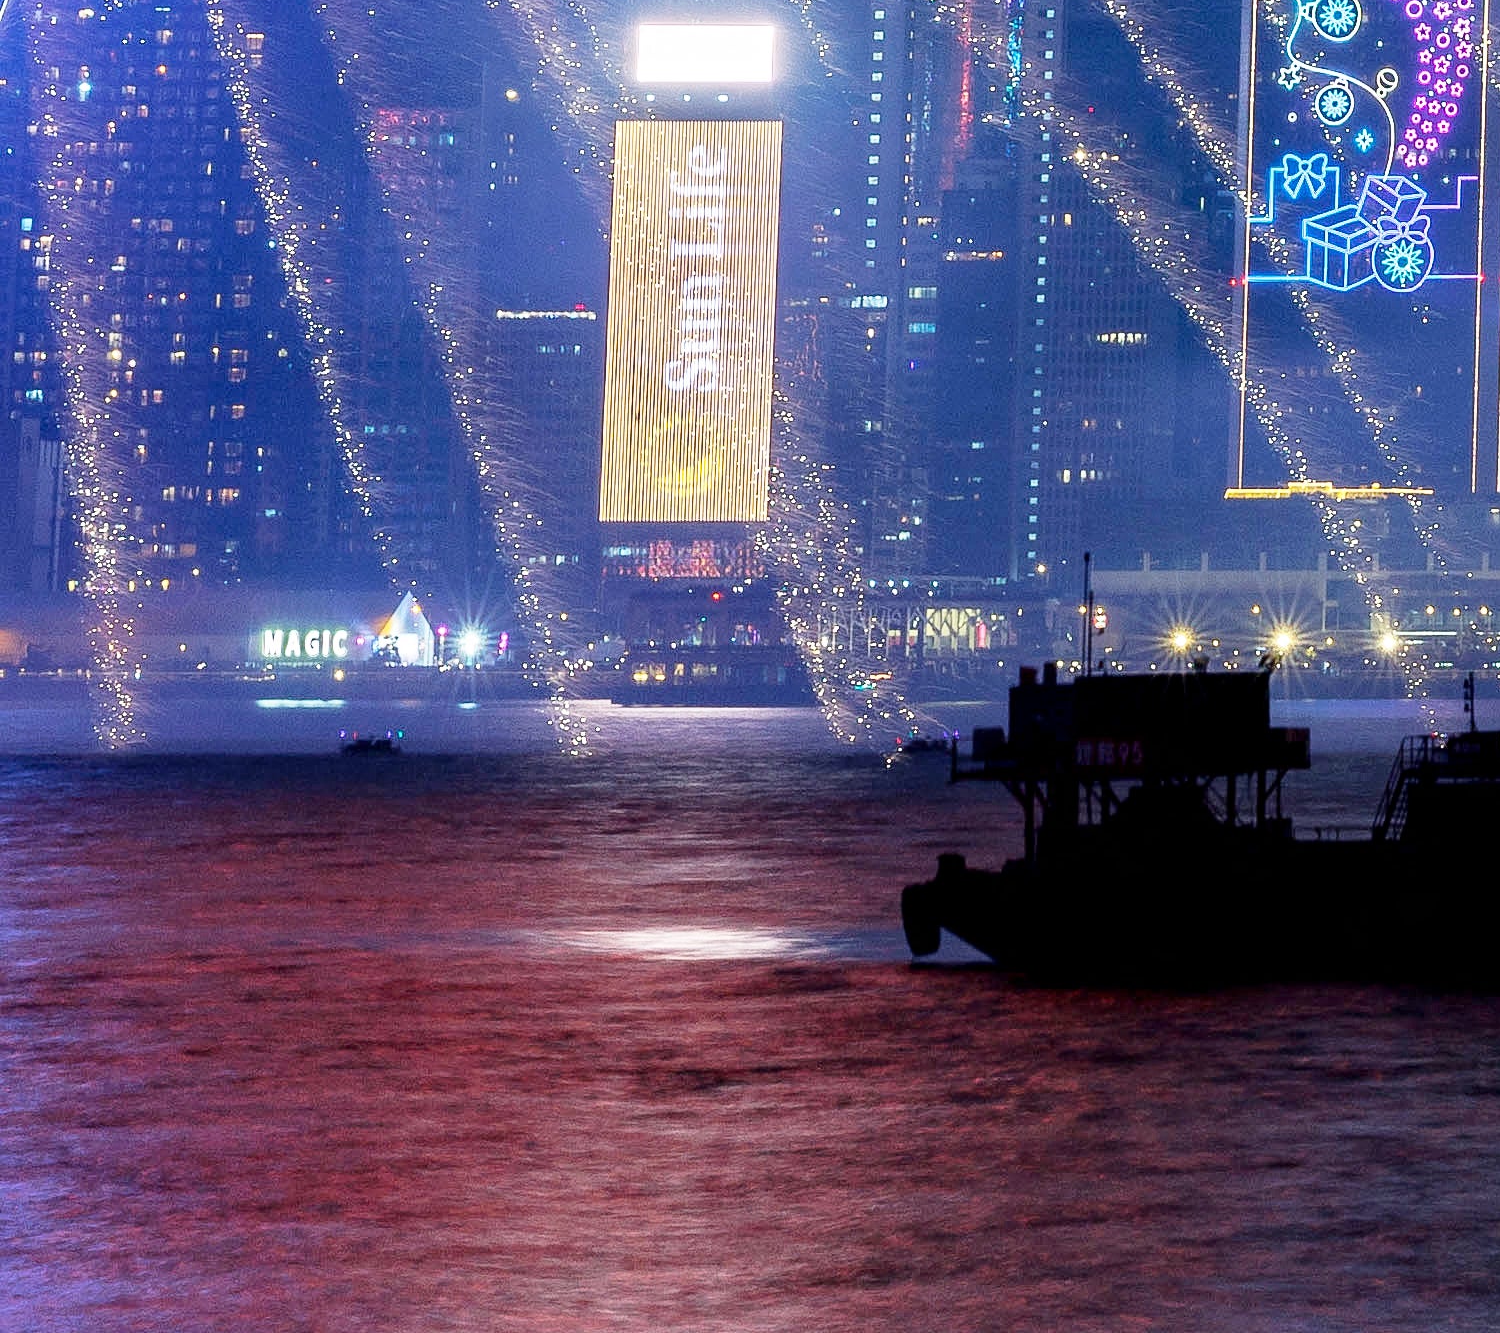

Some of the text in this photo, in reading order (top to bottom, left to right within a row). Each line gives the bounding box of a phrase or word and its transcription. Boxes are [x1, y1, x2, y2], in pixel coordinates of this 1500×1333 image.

[664, 144, 726, 393] Sun Life
[262, 629, 348, 658] MAGIC
